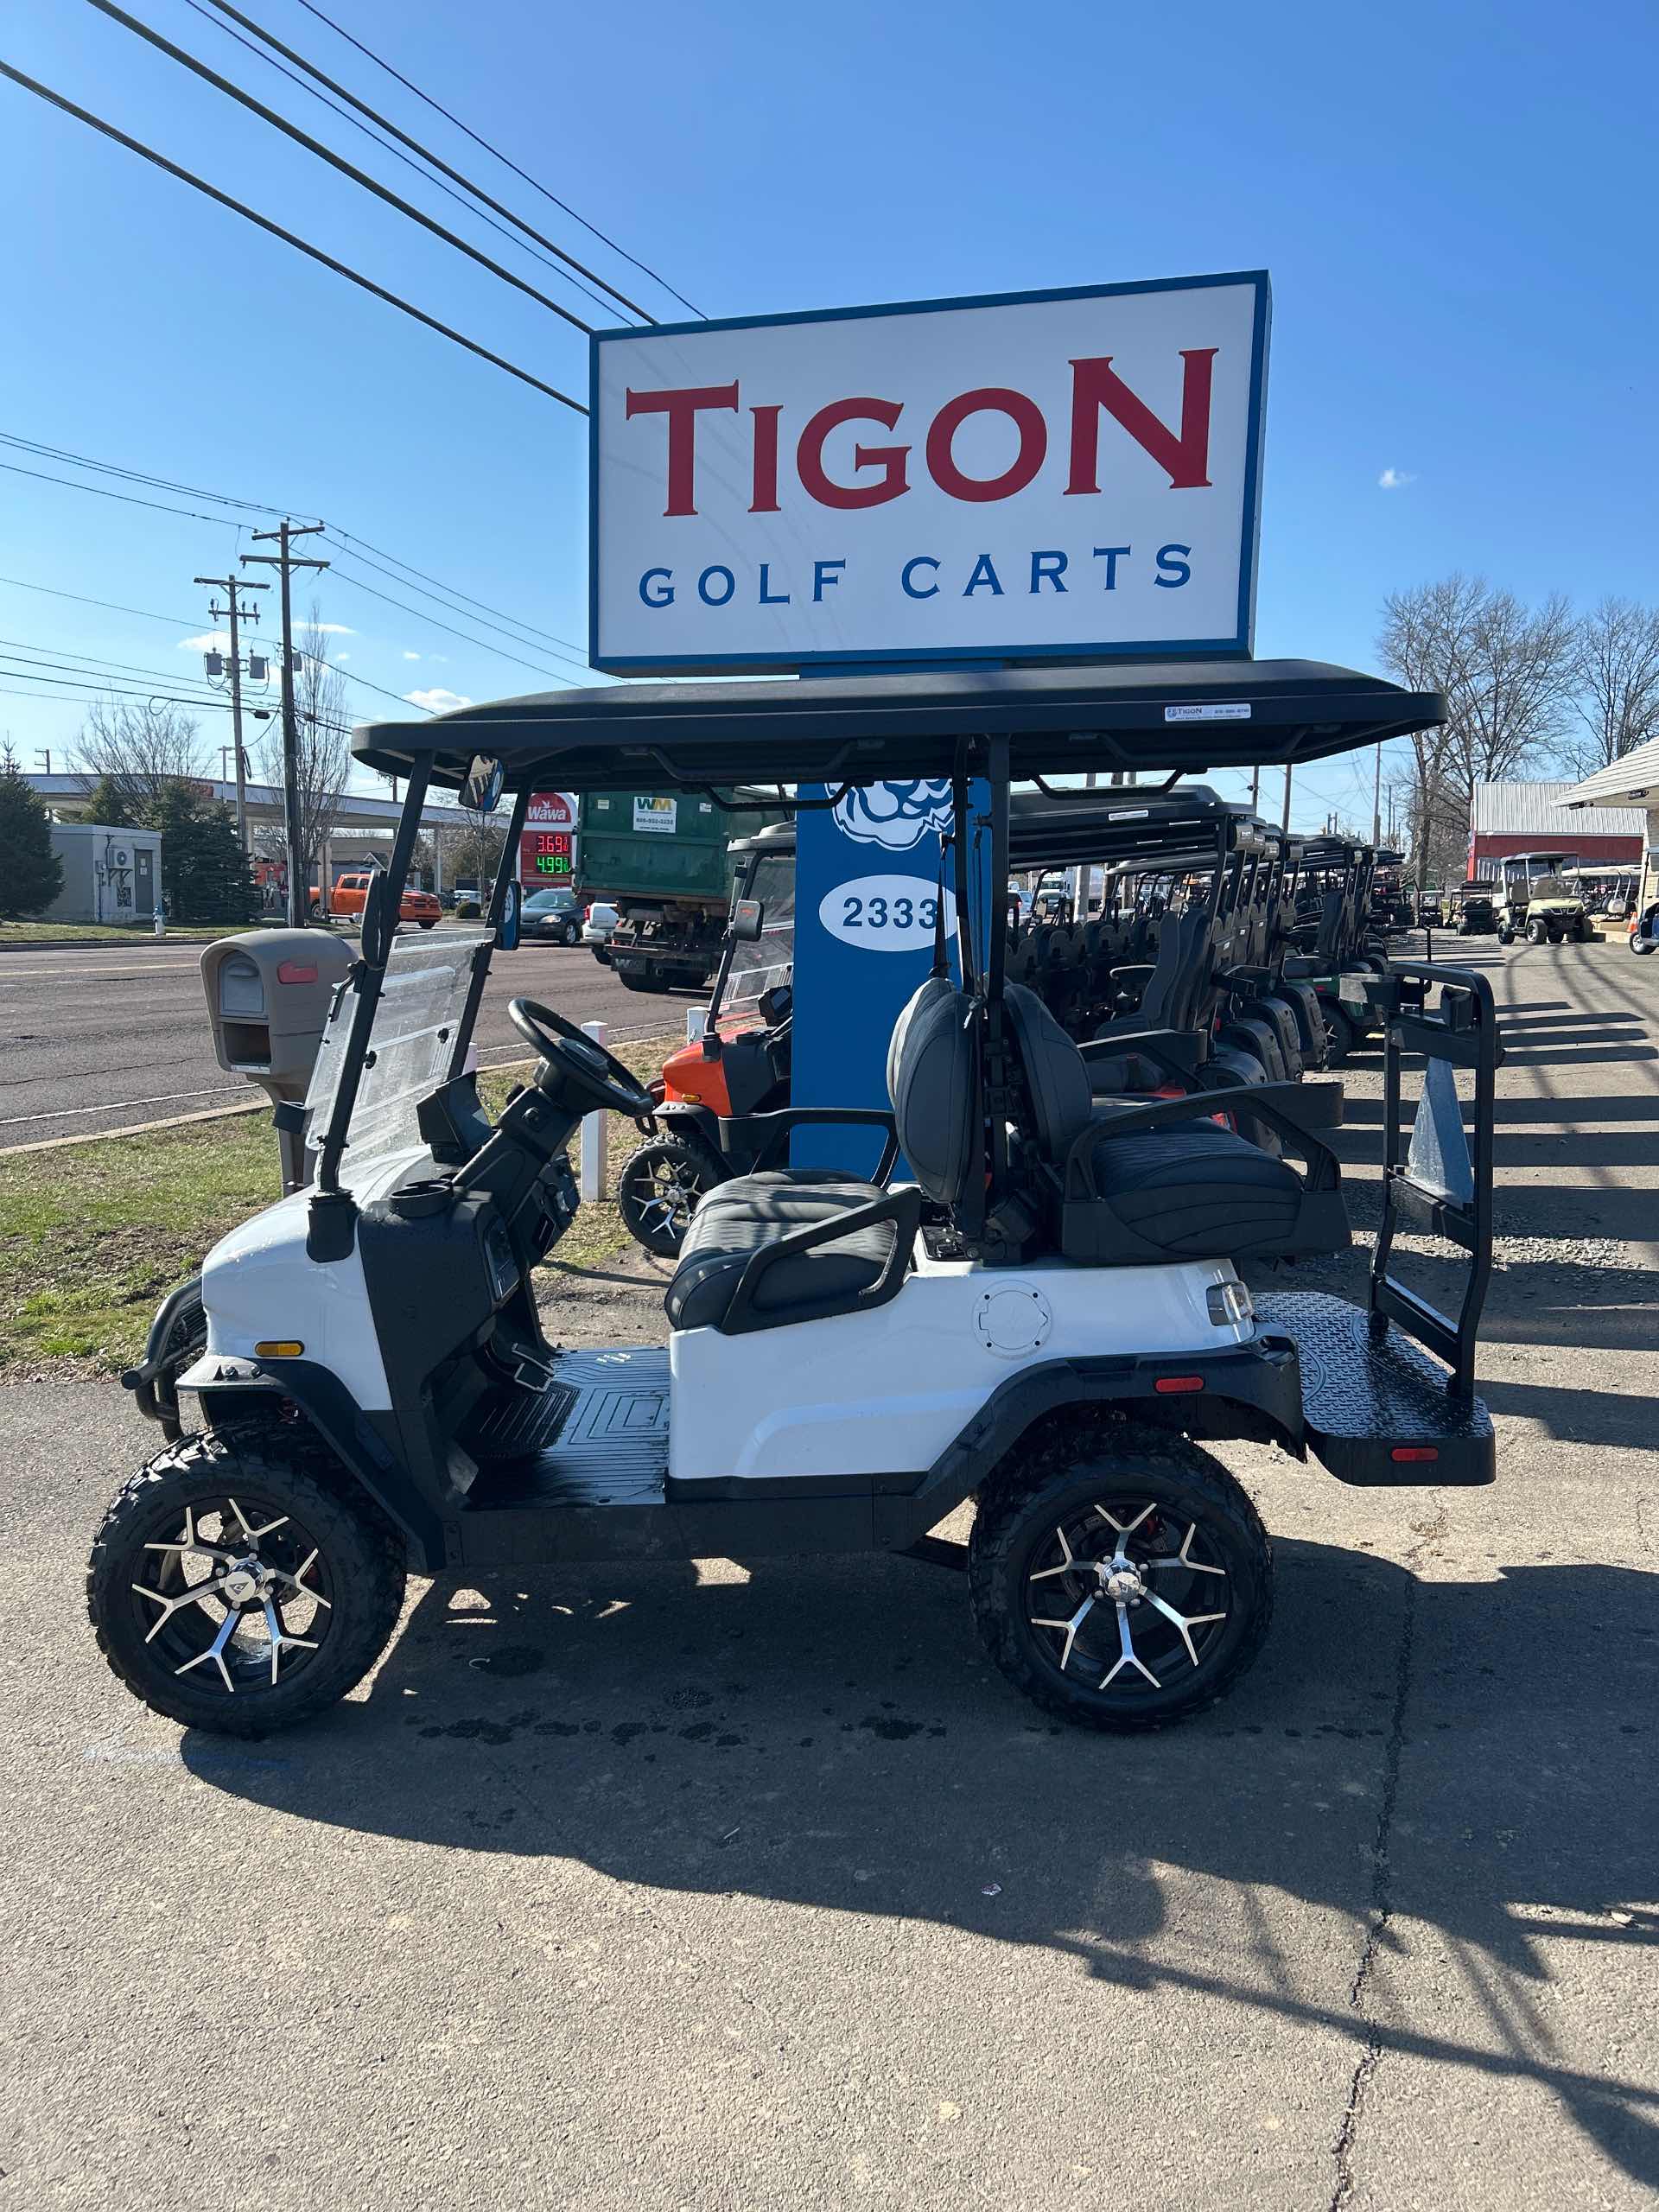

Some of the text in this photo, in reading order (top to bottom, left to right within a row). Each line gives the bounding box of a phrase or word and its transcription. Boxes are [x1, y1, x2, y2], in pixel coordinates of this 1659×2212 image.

[626, 346, 1219, 517] TIGON
[639, 543, 1192, 608] GOLF CARTS
[527, 805, 567, 822] Wawa
[637, 798, 673, 811] WM
[842, 896, 938, 930] 2333
